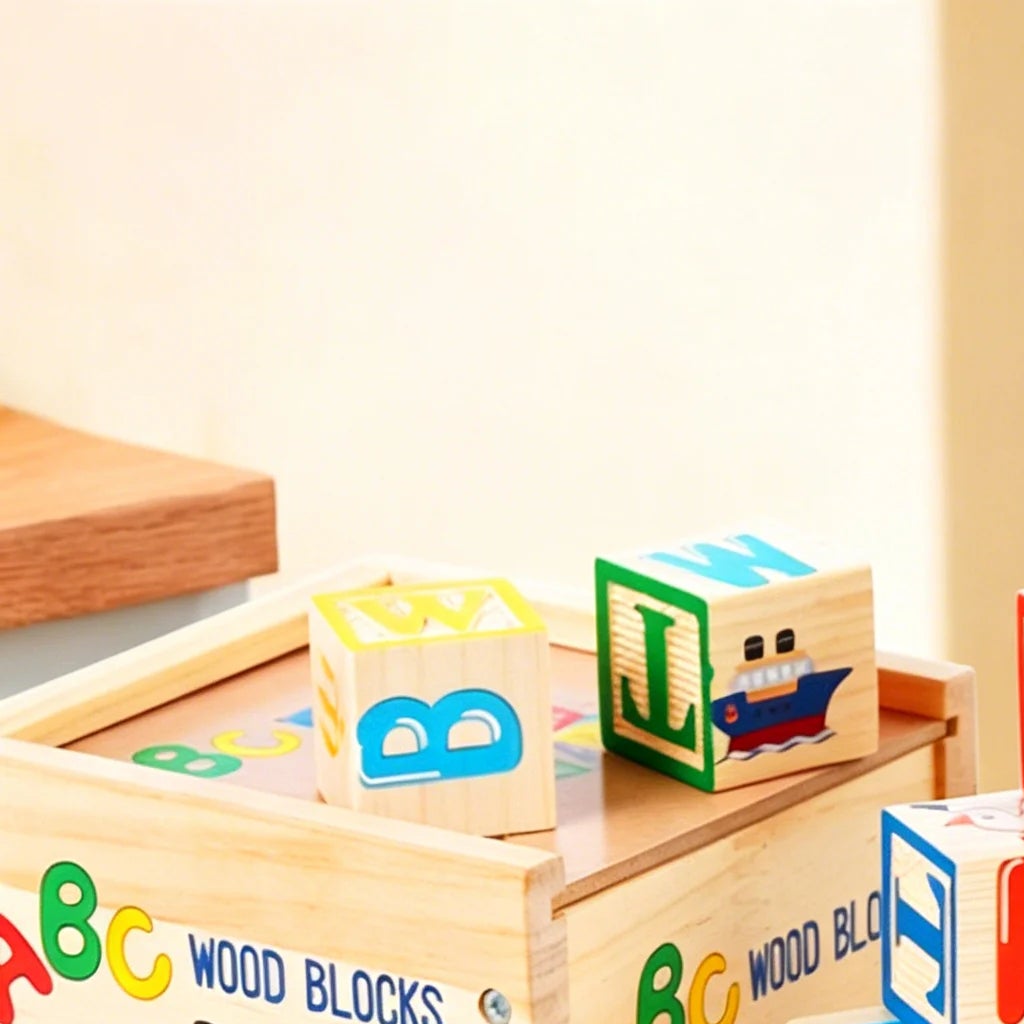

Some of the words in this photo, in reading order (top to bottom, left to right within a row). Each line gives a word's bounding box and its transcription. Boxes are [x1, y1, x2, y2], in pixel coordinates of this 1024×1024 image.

[619, 603, 697, 753] T
[356, 688, 523, 790] B
[188, 933, 285, 1005] WOOD
[749, 920, 819, 1001] WOOD
[834, 890, 881, 961] BLO
